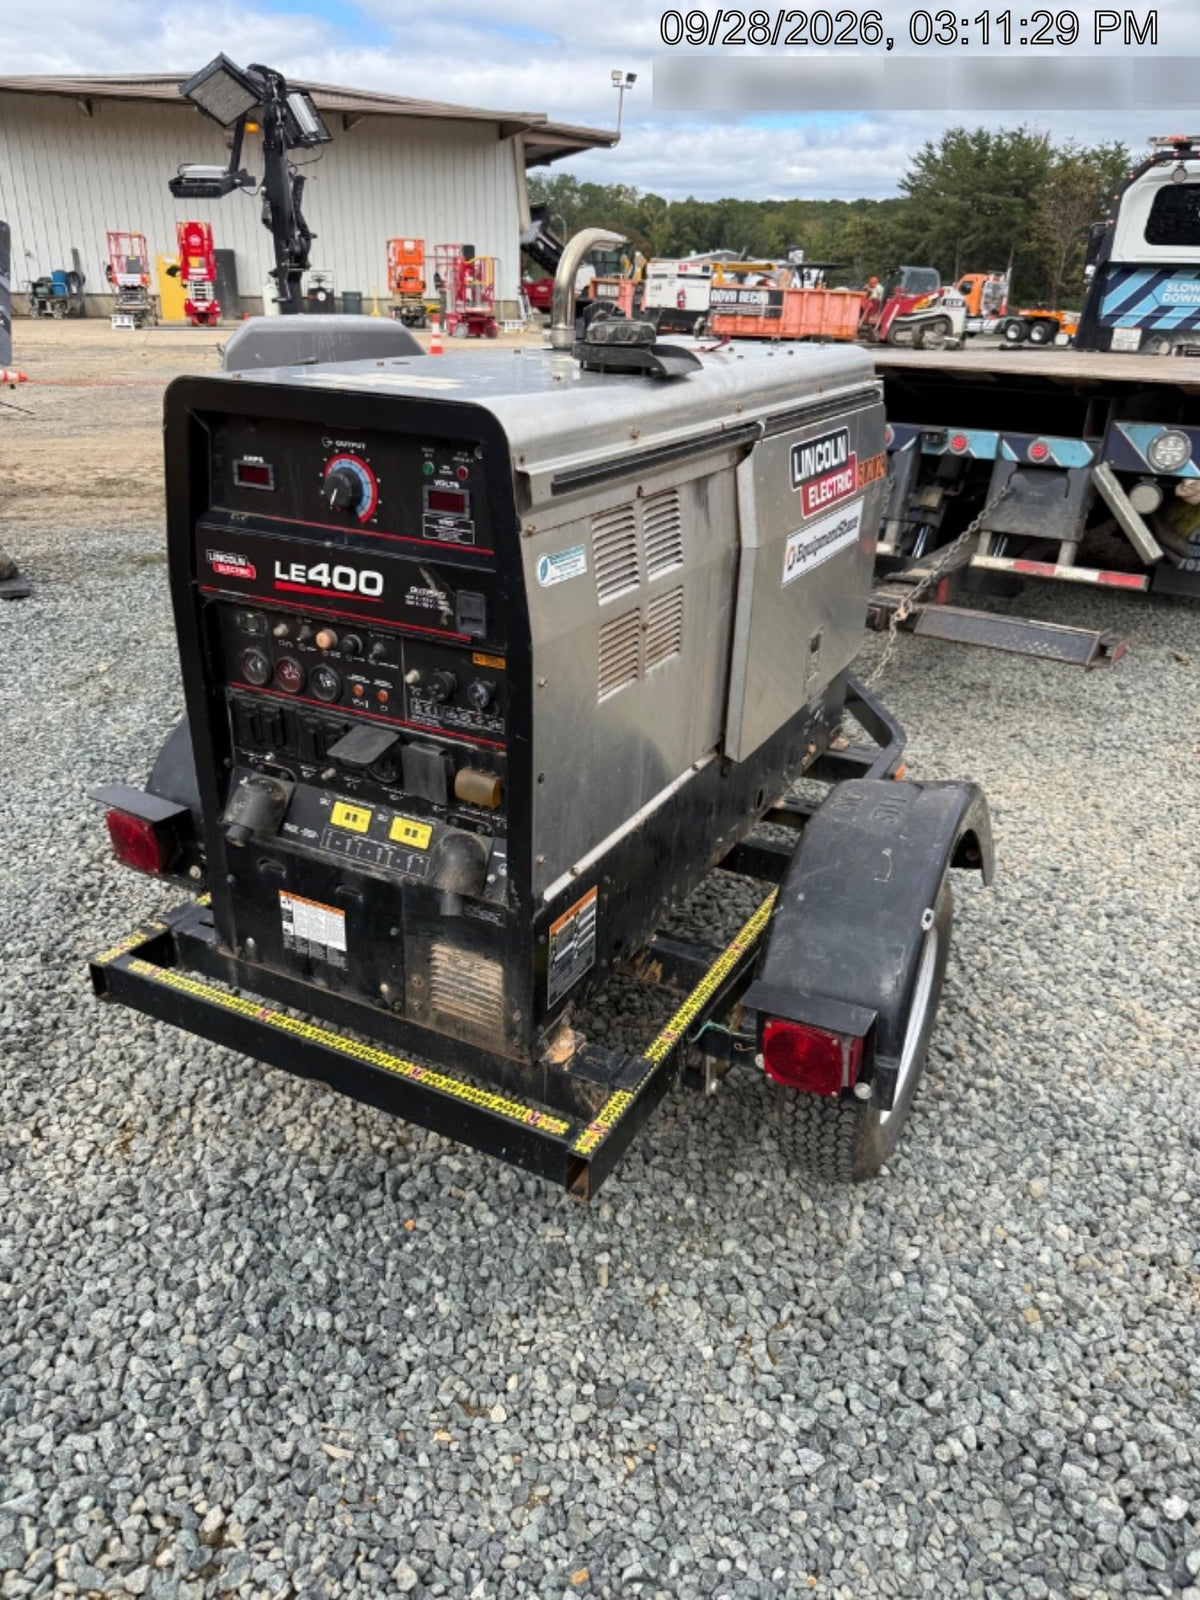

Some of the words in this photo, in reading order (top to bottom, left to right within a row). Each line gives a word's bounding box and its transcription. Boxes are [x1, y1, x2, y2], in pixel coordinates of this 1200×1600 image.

[1162, 292, 1200, 303] DOWN
[335, 440, 365, 450] OUTPUT
[794, 434, 847, 483] LINCOLN
[808, 469, 853, 508] ELECTRIC
[275, 560, 384, 597] LE400
